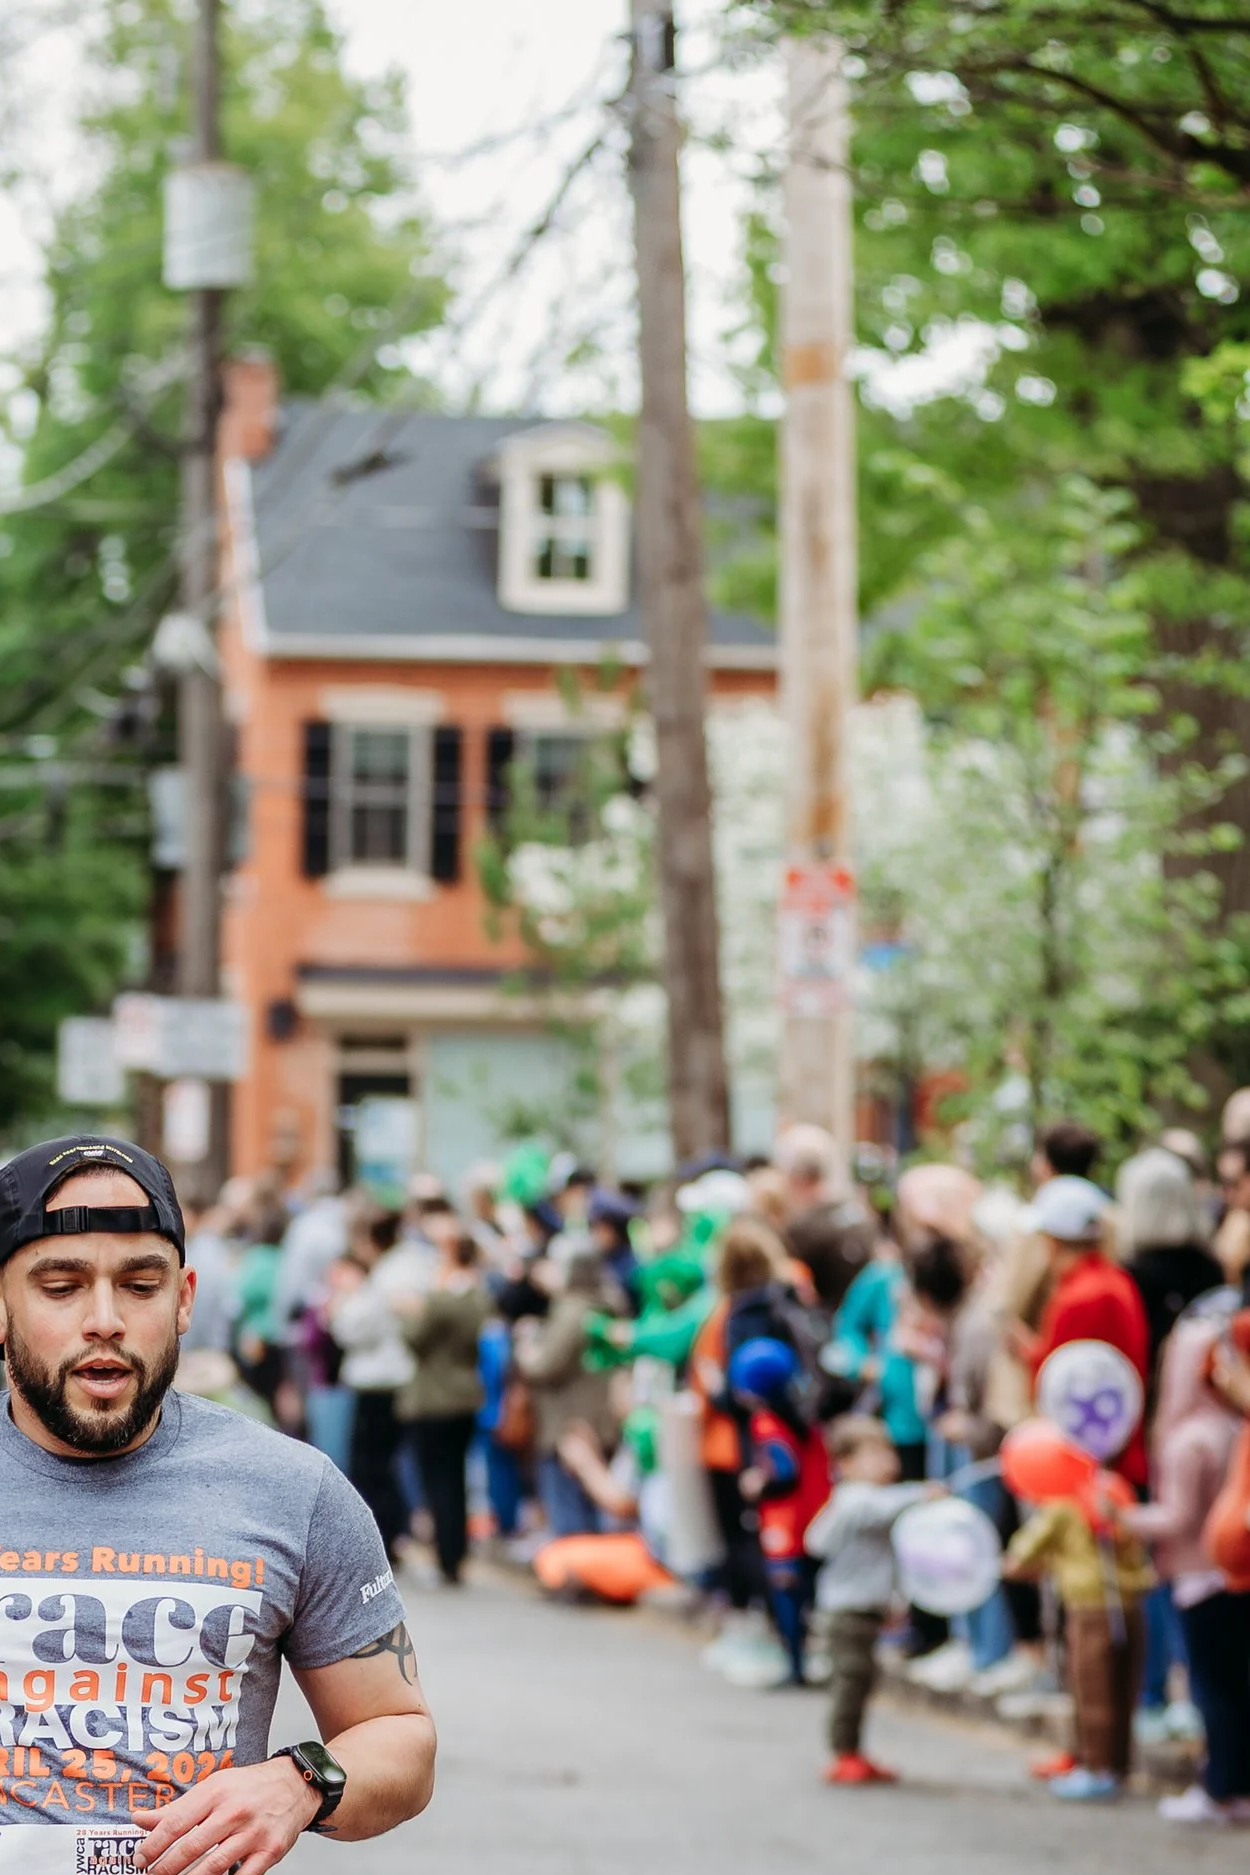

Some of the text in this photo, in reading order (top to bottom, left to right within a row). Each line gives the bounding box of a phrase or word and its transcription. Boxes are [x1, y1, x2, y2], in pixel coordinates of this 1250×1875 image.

[91, 1546, 265, 1589] Running!
[360, 1569, 392, 1604] Fult
[61, 1748, 132, 1783] 25,
[76, 1837, 88, 1874] ywca
[87, 1864, 148, 1875] RACISM
